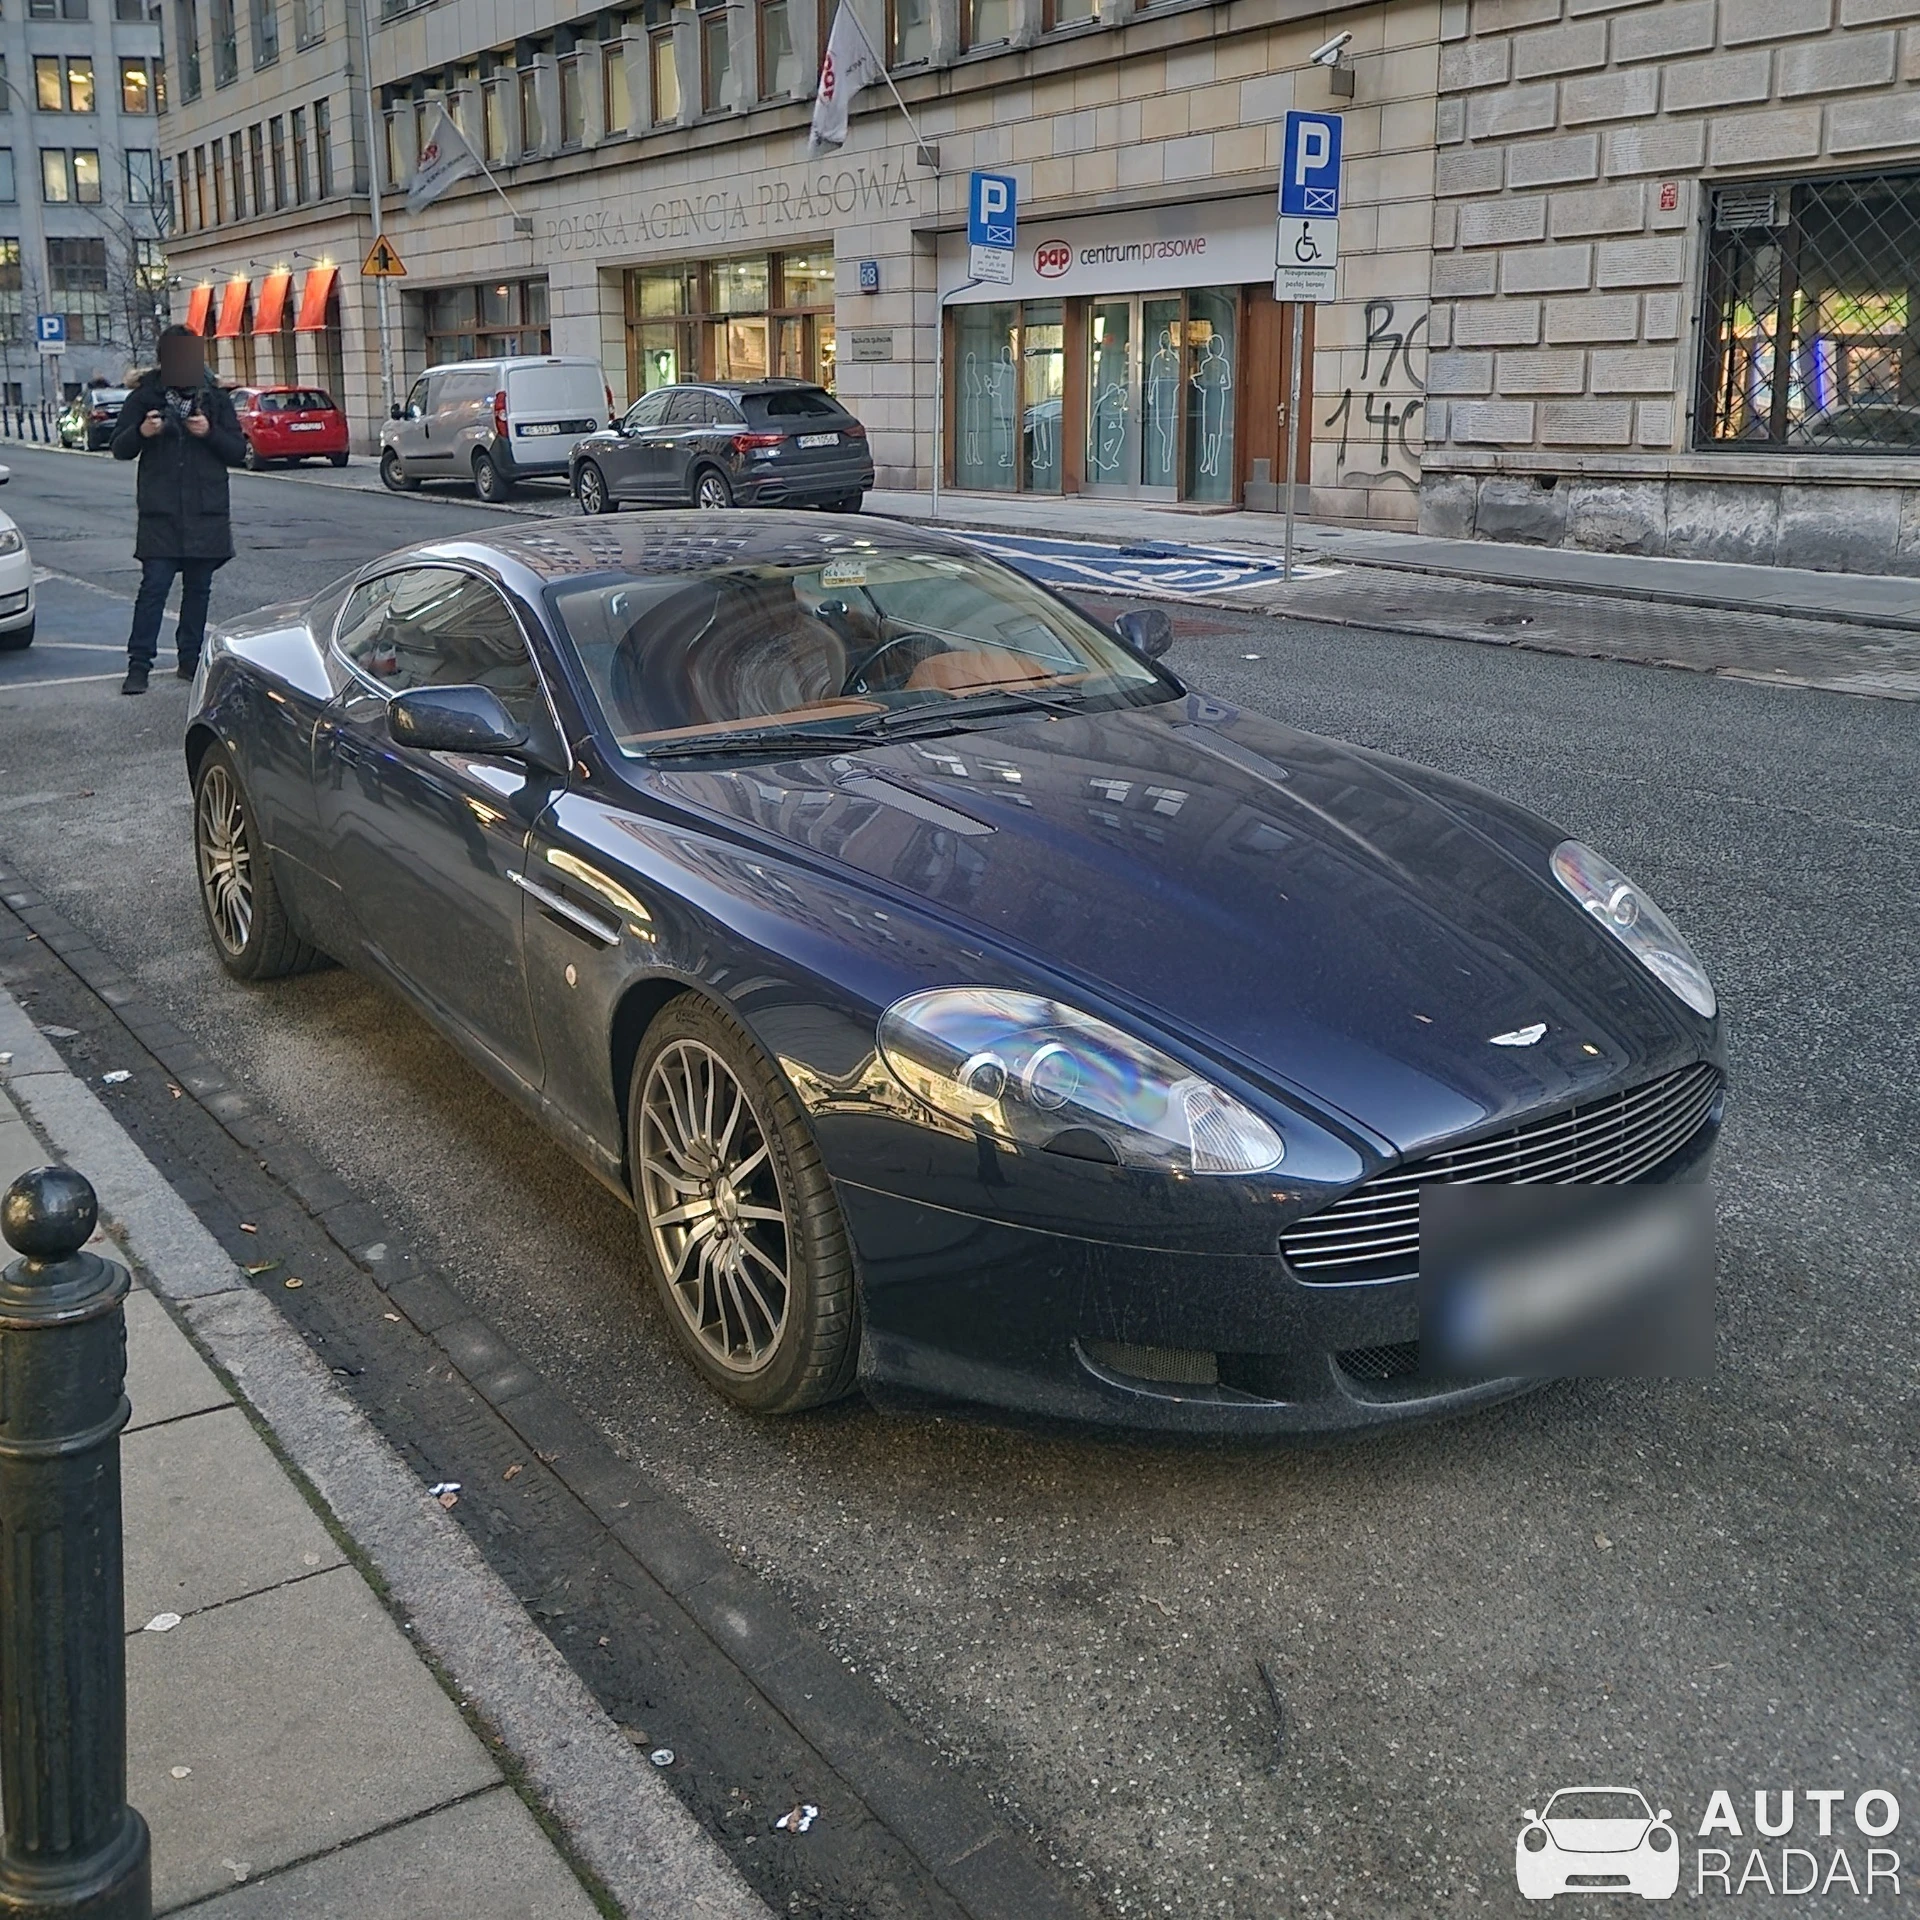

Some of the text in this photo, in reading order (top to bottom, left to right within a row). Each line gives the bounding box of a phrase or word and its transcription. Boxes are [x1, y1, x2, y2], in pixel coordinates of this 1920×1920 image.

[1296, 121, 1331, 186] P
[546, 163, 917, 254] POLSKA AGENCJA PRASOWA
[981, 179, 1007, 224] P
[1038, 248, 1070, 273] pap
[42, 317, 60, 339] P
[772, 1133, 805, 1257] MICHELIN
